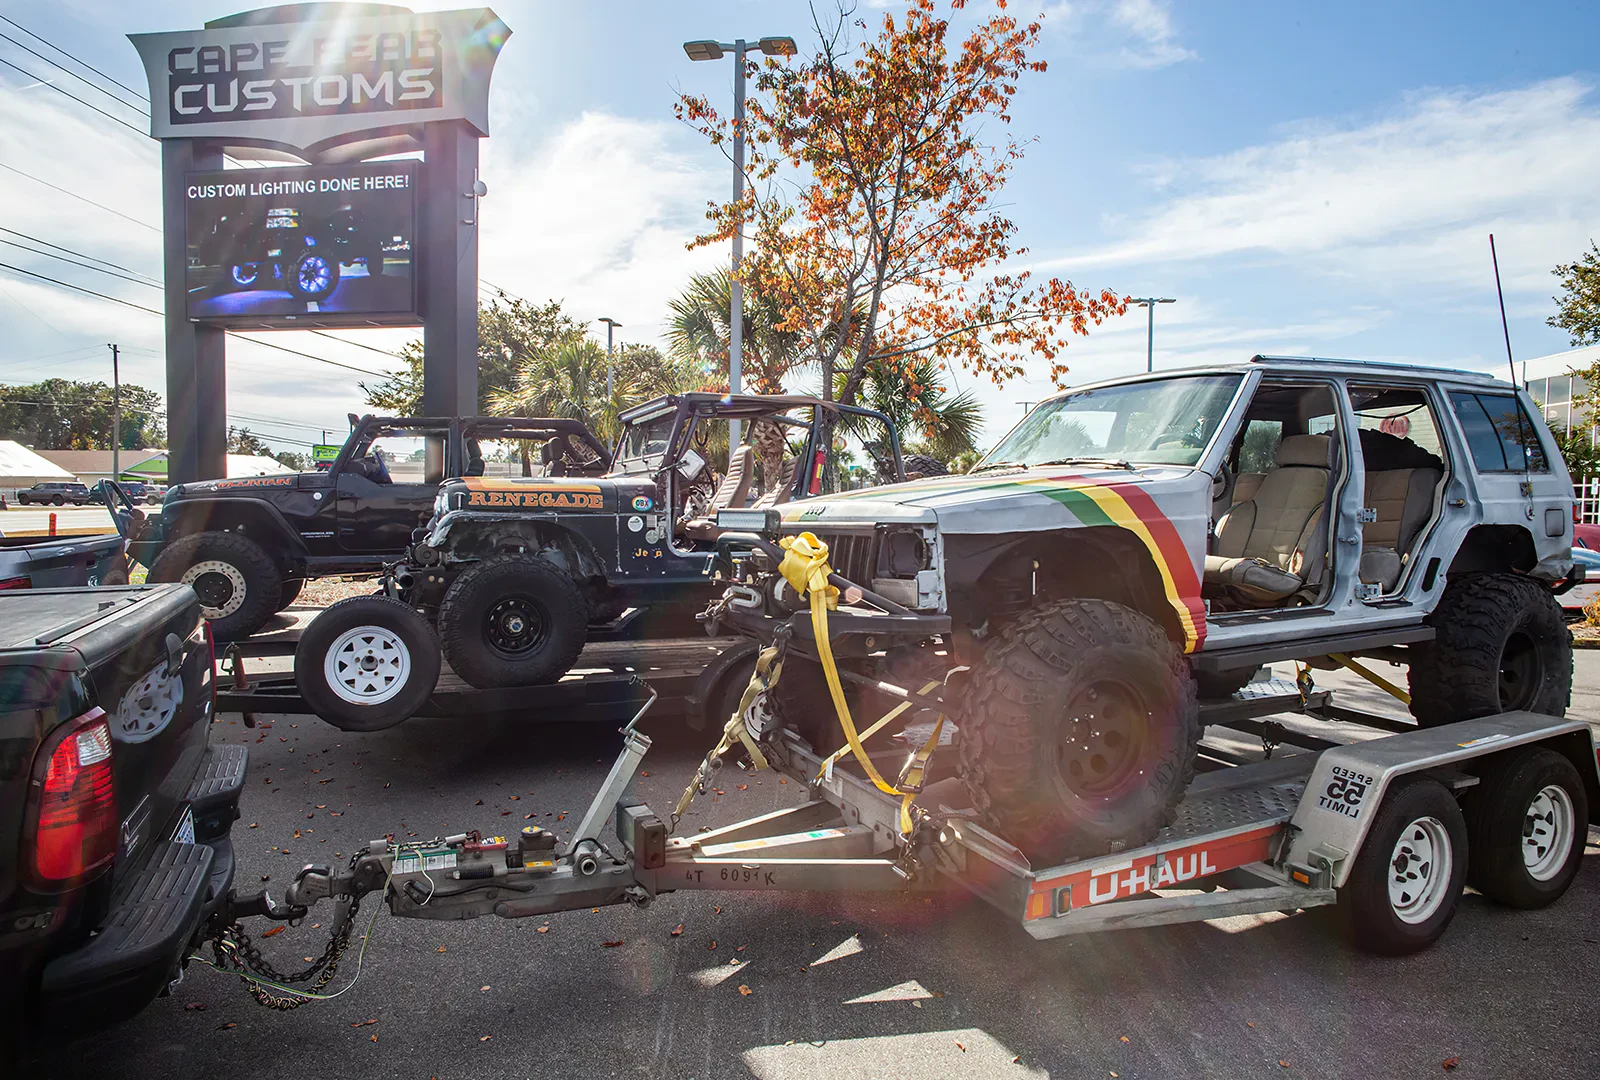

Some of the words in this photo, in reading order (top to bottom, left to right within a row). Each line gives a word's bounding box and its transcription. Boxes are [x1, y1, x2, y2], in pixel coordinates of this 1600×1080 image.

[168, 40, 290, 75] CAPE
[174, 67, 435, 115] CUSTOMS
[187, 183, 247, 199] CUSTOM
[250, 180, 316, 196] LIGHTING
[320, 177, 360, 192] DONE
[364, 174, 409, 188] HERE!
[468, 491, 603, 509] RENEGADE
[1089, 851, 1216, 904] U-HAUL
